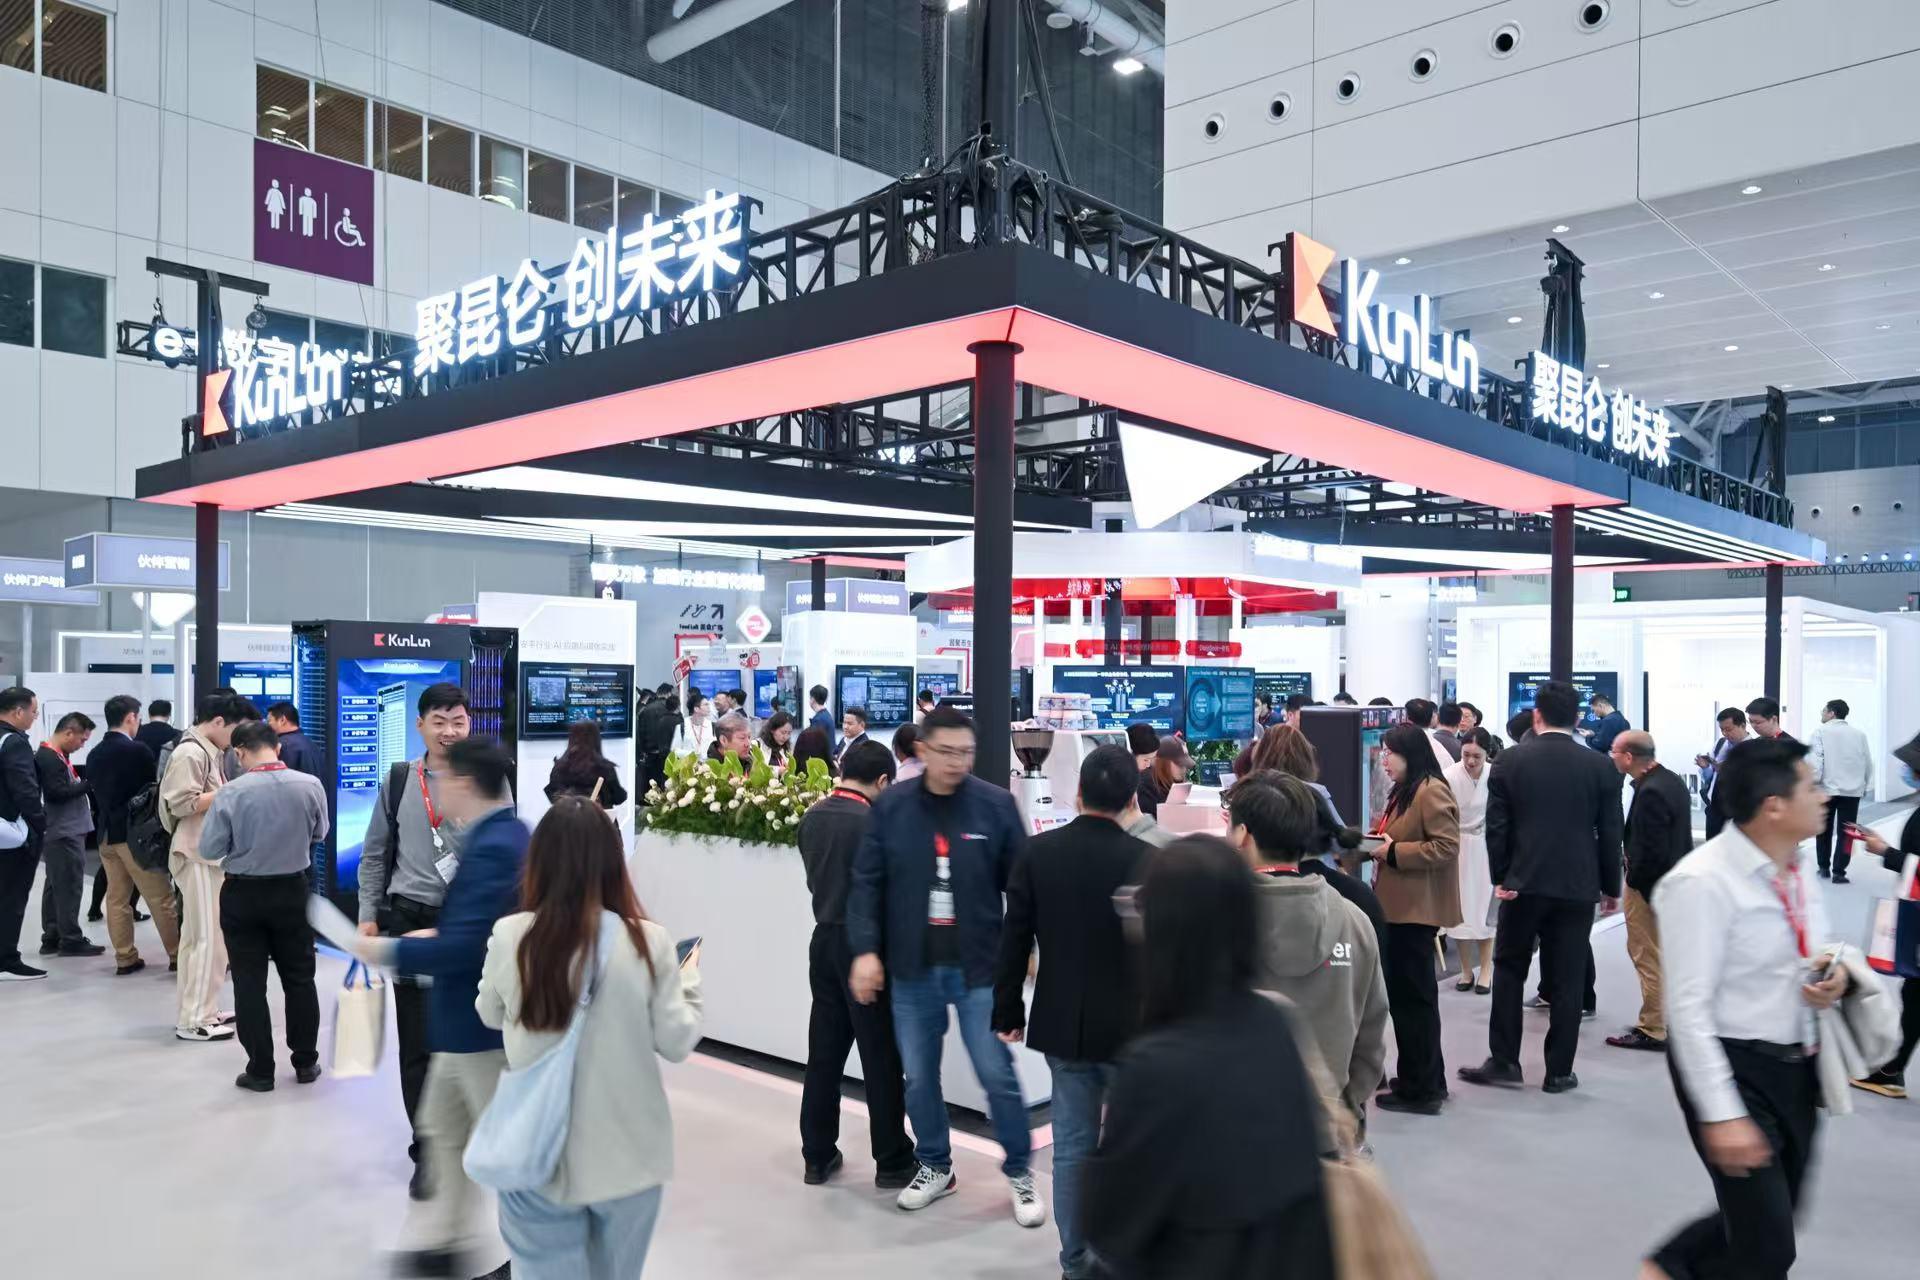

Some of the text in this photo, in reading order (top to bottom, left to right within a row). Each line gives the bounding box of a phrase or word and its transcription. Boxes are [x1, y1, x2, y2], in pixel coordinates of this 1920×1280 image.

[414, 188, 743, 377] 聚昆仑 创未来
[1343, 256, 1479, 394] KunLun
[234, 346, 343, 428] KunLun
[1533, 350, 1679, 469] 聚昆仑 创未来
[388, 633, 431, 648] KunLun
